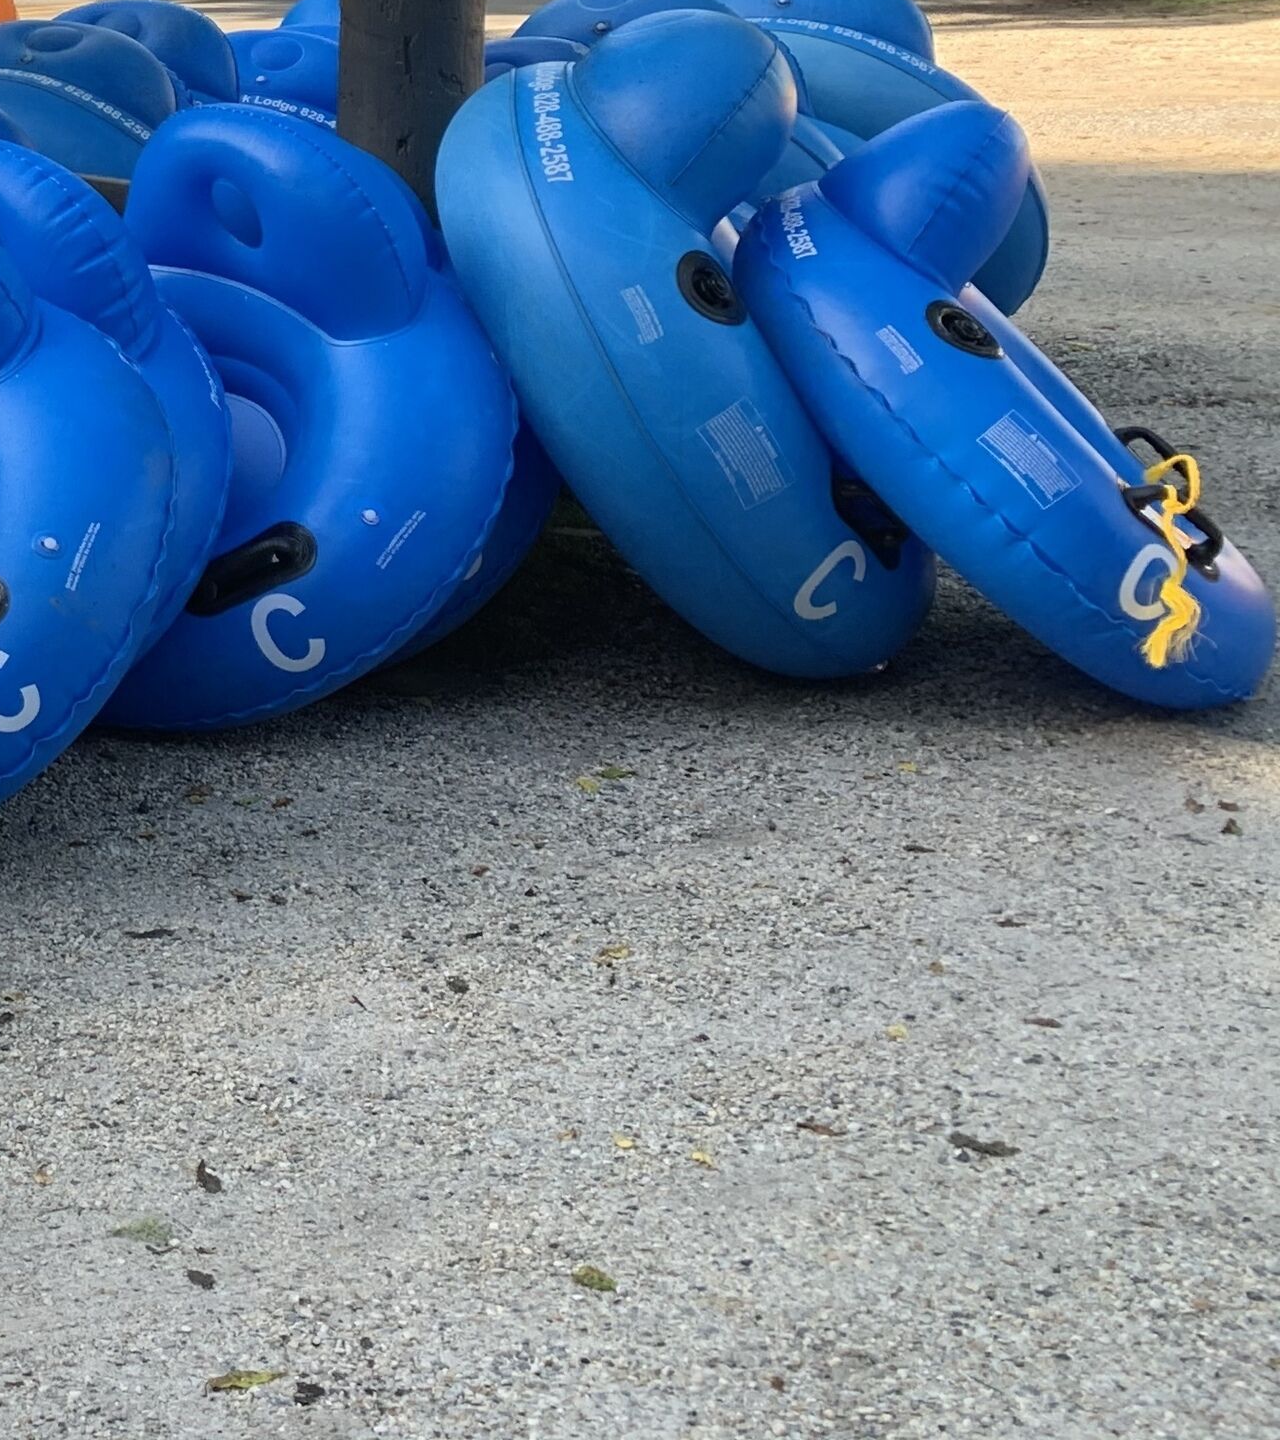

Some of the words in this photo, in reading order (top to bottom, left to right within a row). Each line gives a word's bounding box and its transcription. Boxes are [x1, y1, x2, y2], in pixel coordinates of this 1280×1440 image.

[64, 83, 152, 141] 828-488-258
[254, 94, 298, 113] Lodge
[533, 91, 574, 182] 828-488-2587
[793, 540, 867, 620] C
[251, 593, 326, 672] C
